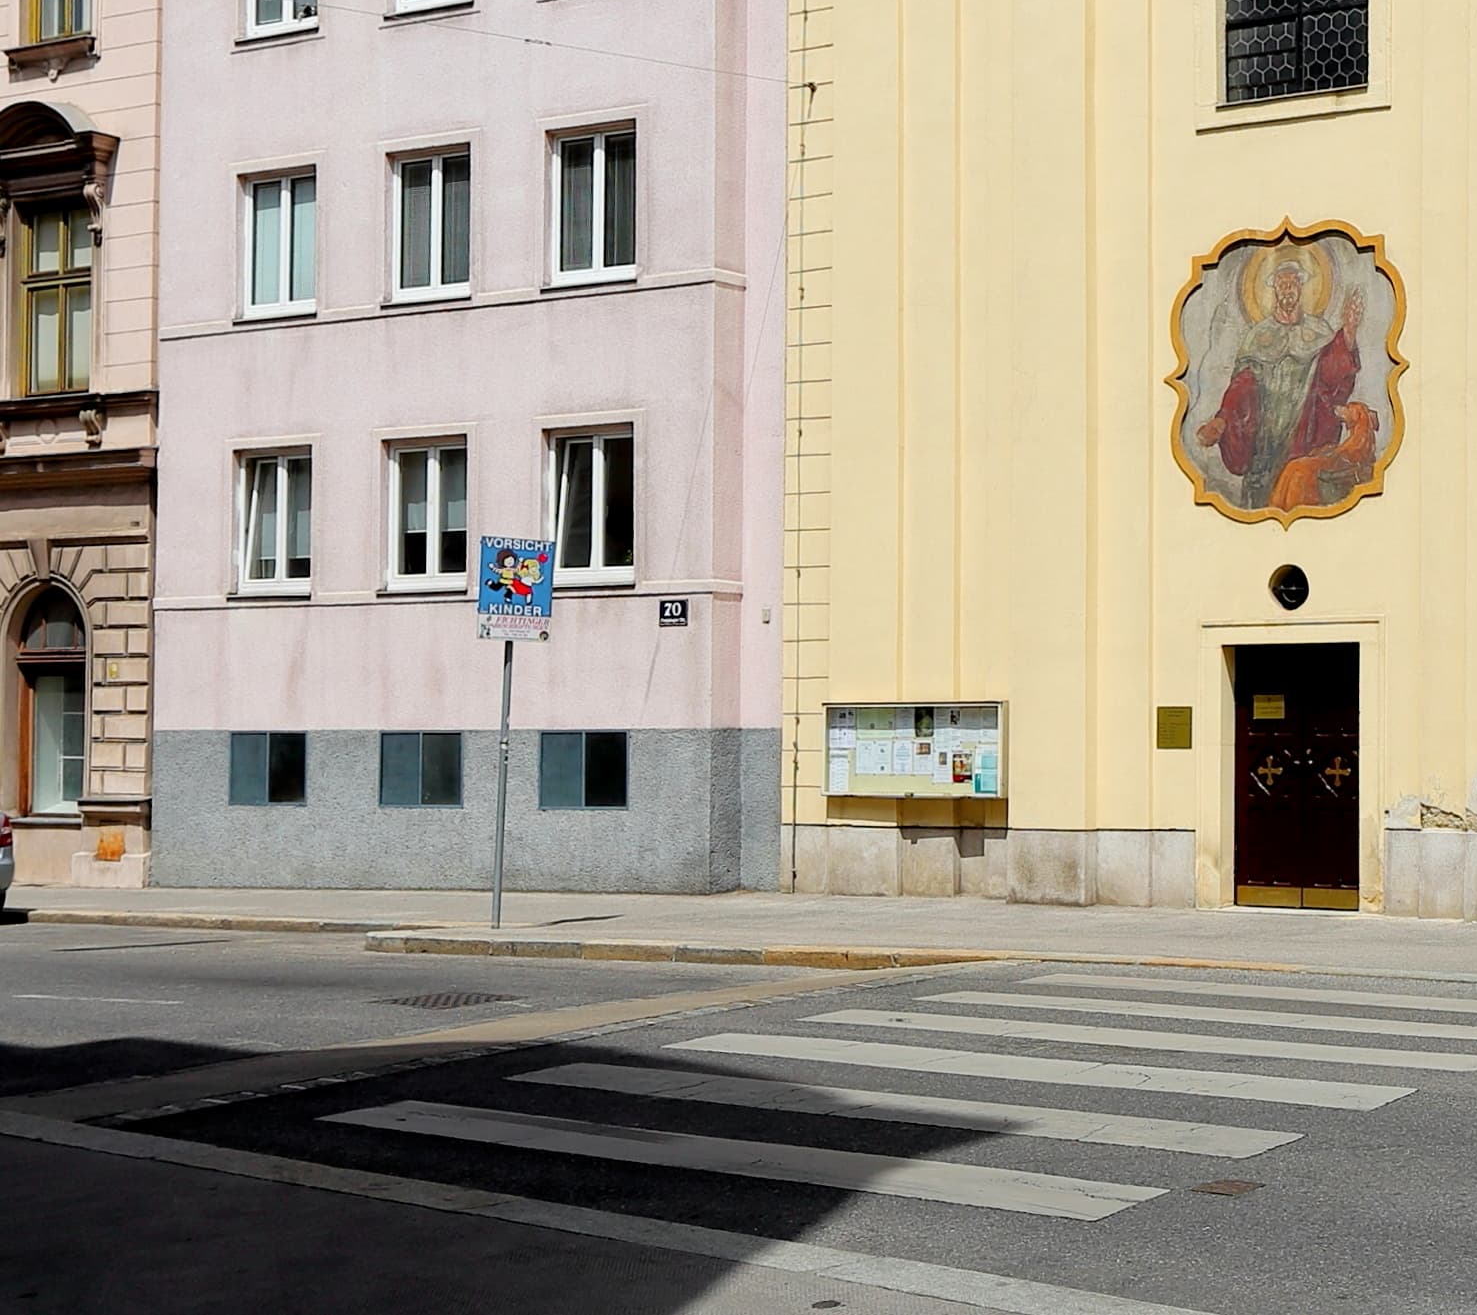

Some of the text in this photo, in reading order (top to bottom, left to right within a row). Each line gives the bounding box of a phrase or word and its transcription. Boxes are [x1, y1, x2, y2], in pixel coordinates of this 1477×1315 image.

[485, 537, 552, 552] VORSICHT
[489, 603, 542, 616] KINDER
[663, 601, 682, 617] 70
